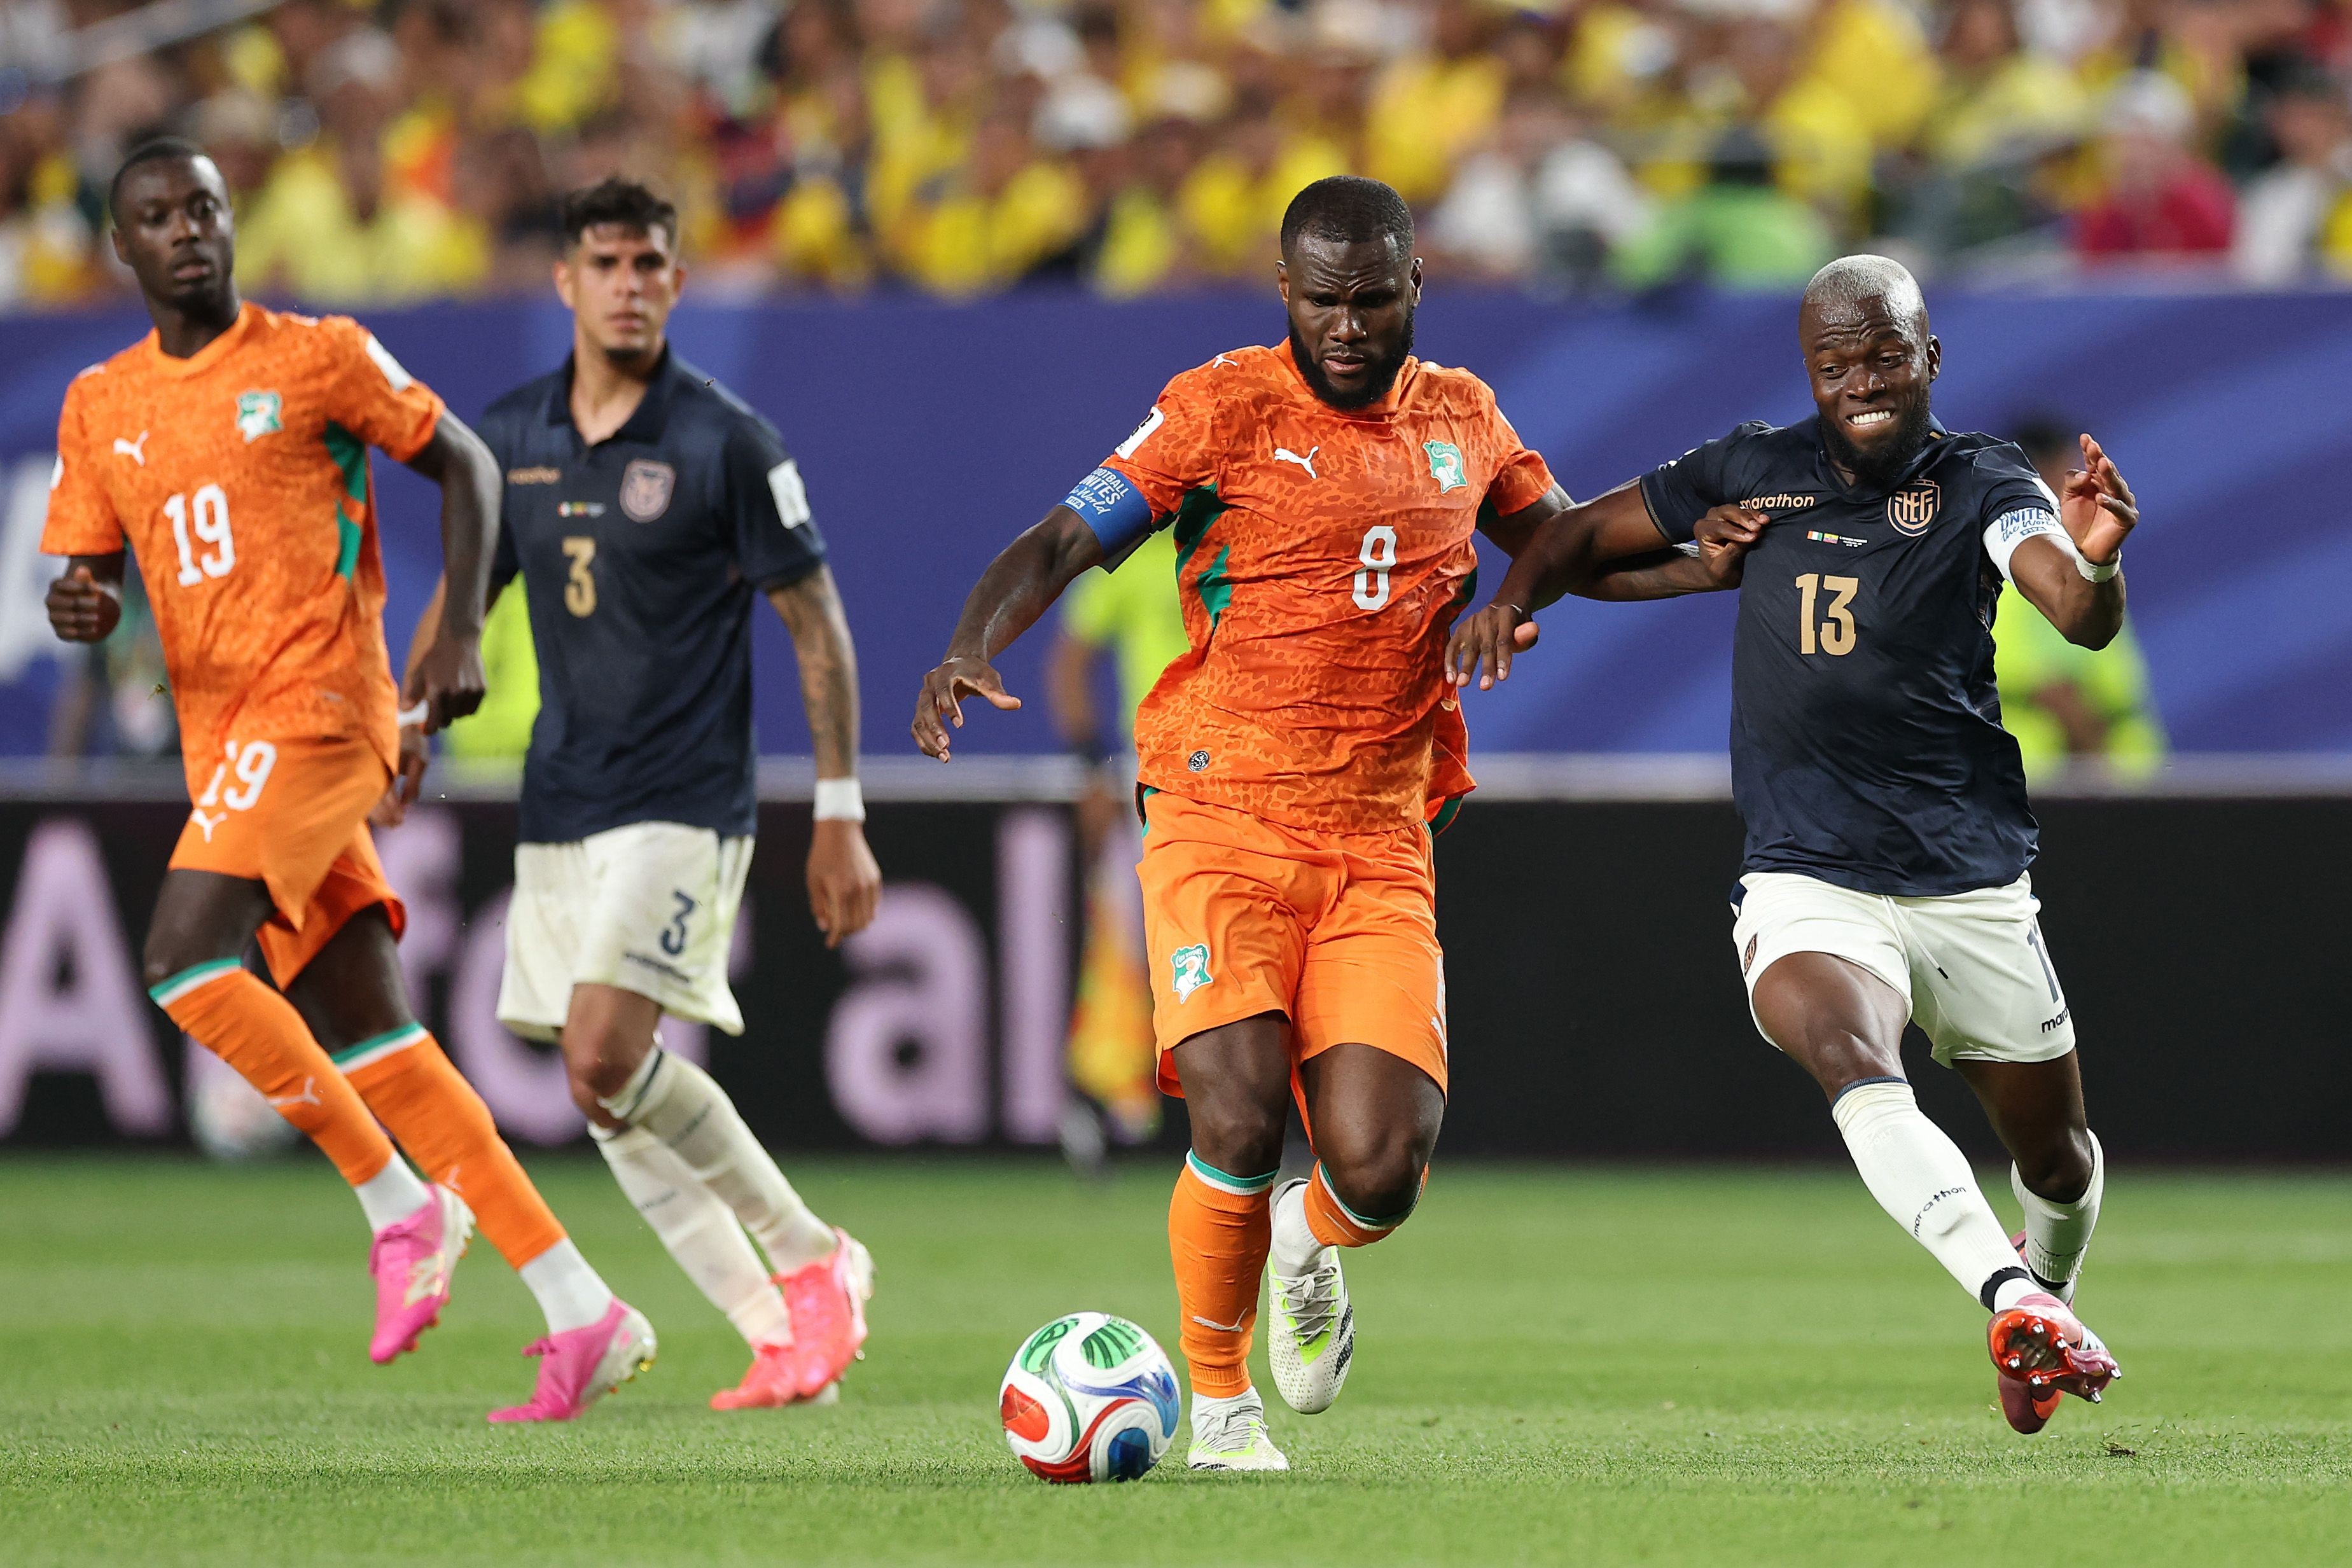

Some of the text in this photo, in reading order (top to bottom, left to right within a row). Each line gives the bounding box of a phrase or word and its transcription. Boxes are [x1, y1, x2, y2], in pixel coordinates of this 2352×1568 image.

[164, 483, 236, 588] 19
[1077, 487, 1111, 515] World
[1739, 494, 1814, 510] marathon
[562, 536, 597, 619] 3
[1351, 525, 1397, 611] 8
[1795, 573, 1859, 656] 13
[198, 740, 278, 811] 19
[662, 891, 695, 955] 3
[2026, 919, 2065, 1004] 1
[1914, 1187, 1966, 1237] marathon
